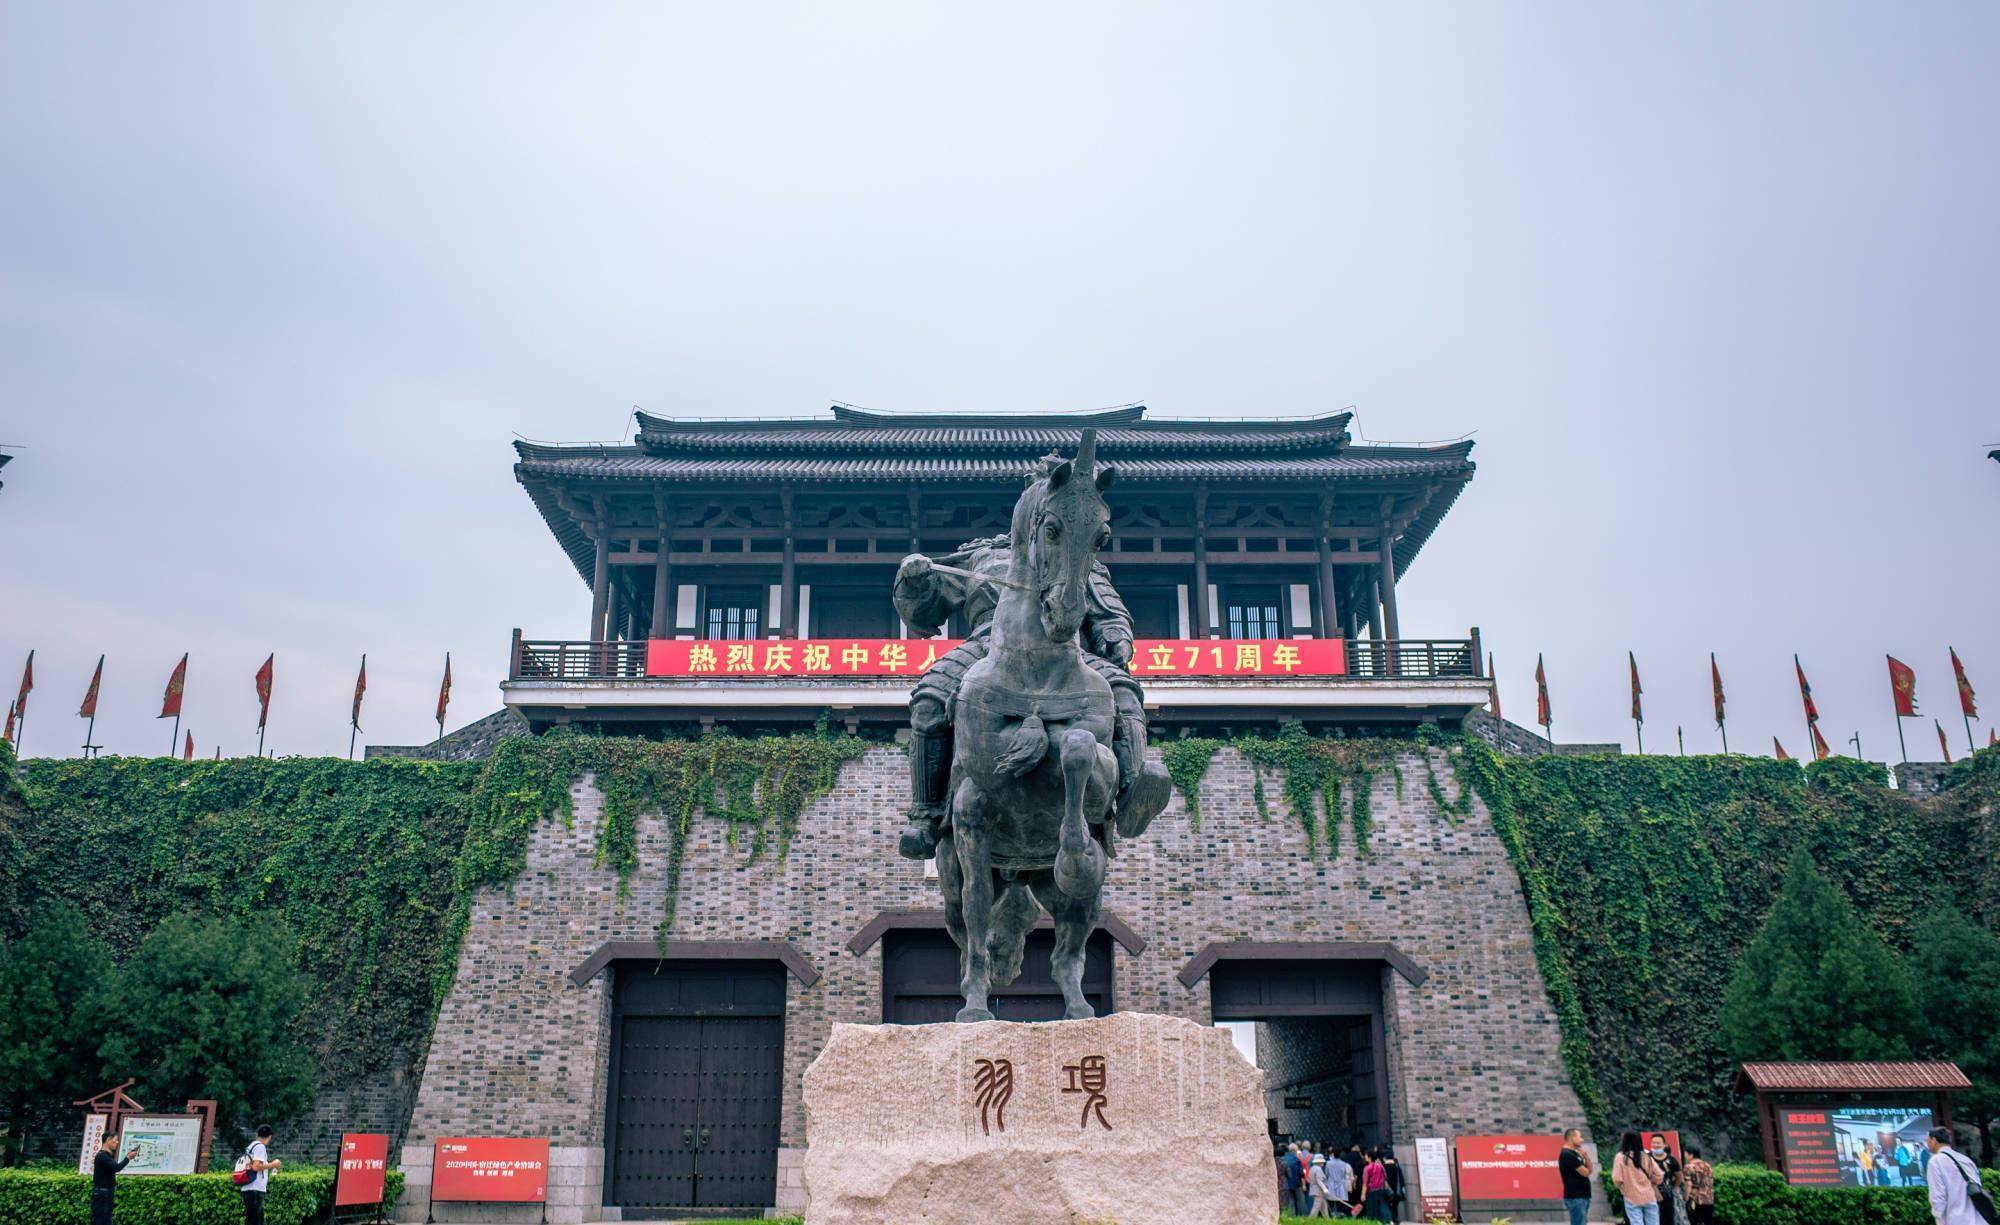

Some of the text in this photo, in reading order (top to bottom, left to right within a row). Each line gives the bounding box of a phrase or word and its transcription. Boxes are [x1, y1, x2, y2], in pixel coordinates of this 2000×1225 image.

[688, 643, 936, 672] 热烈庆祝中华人
